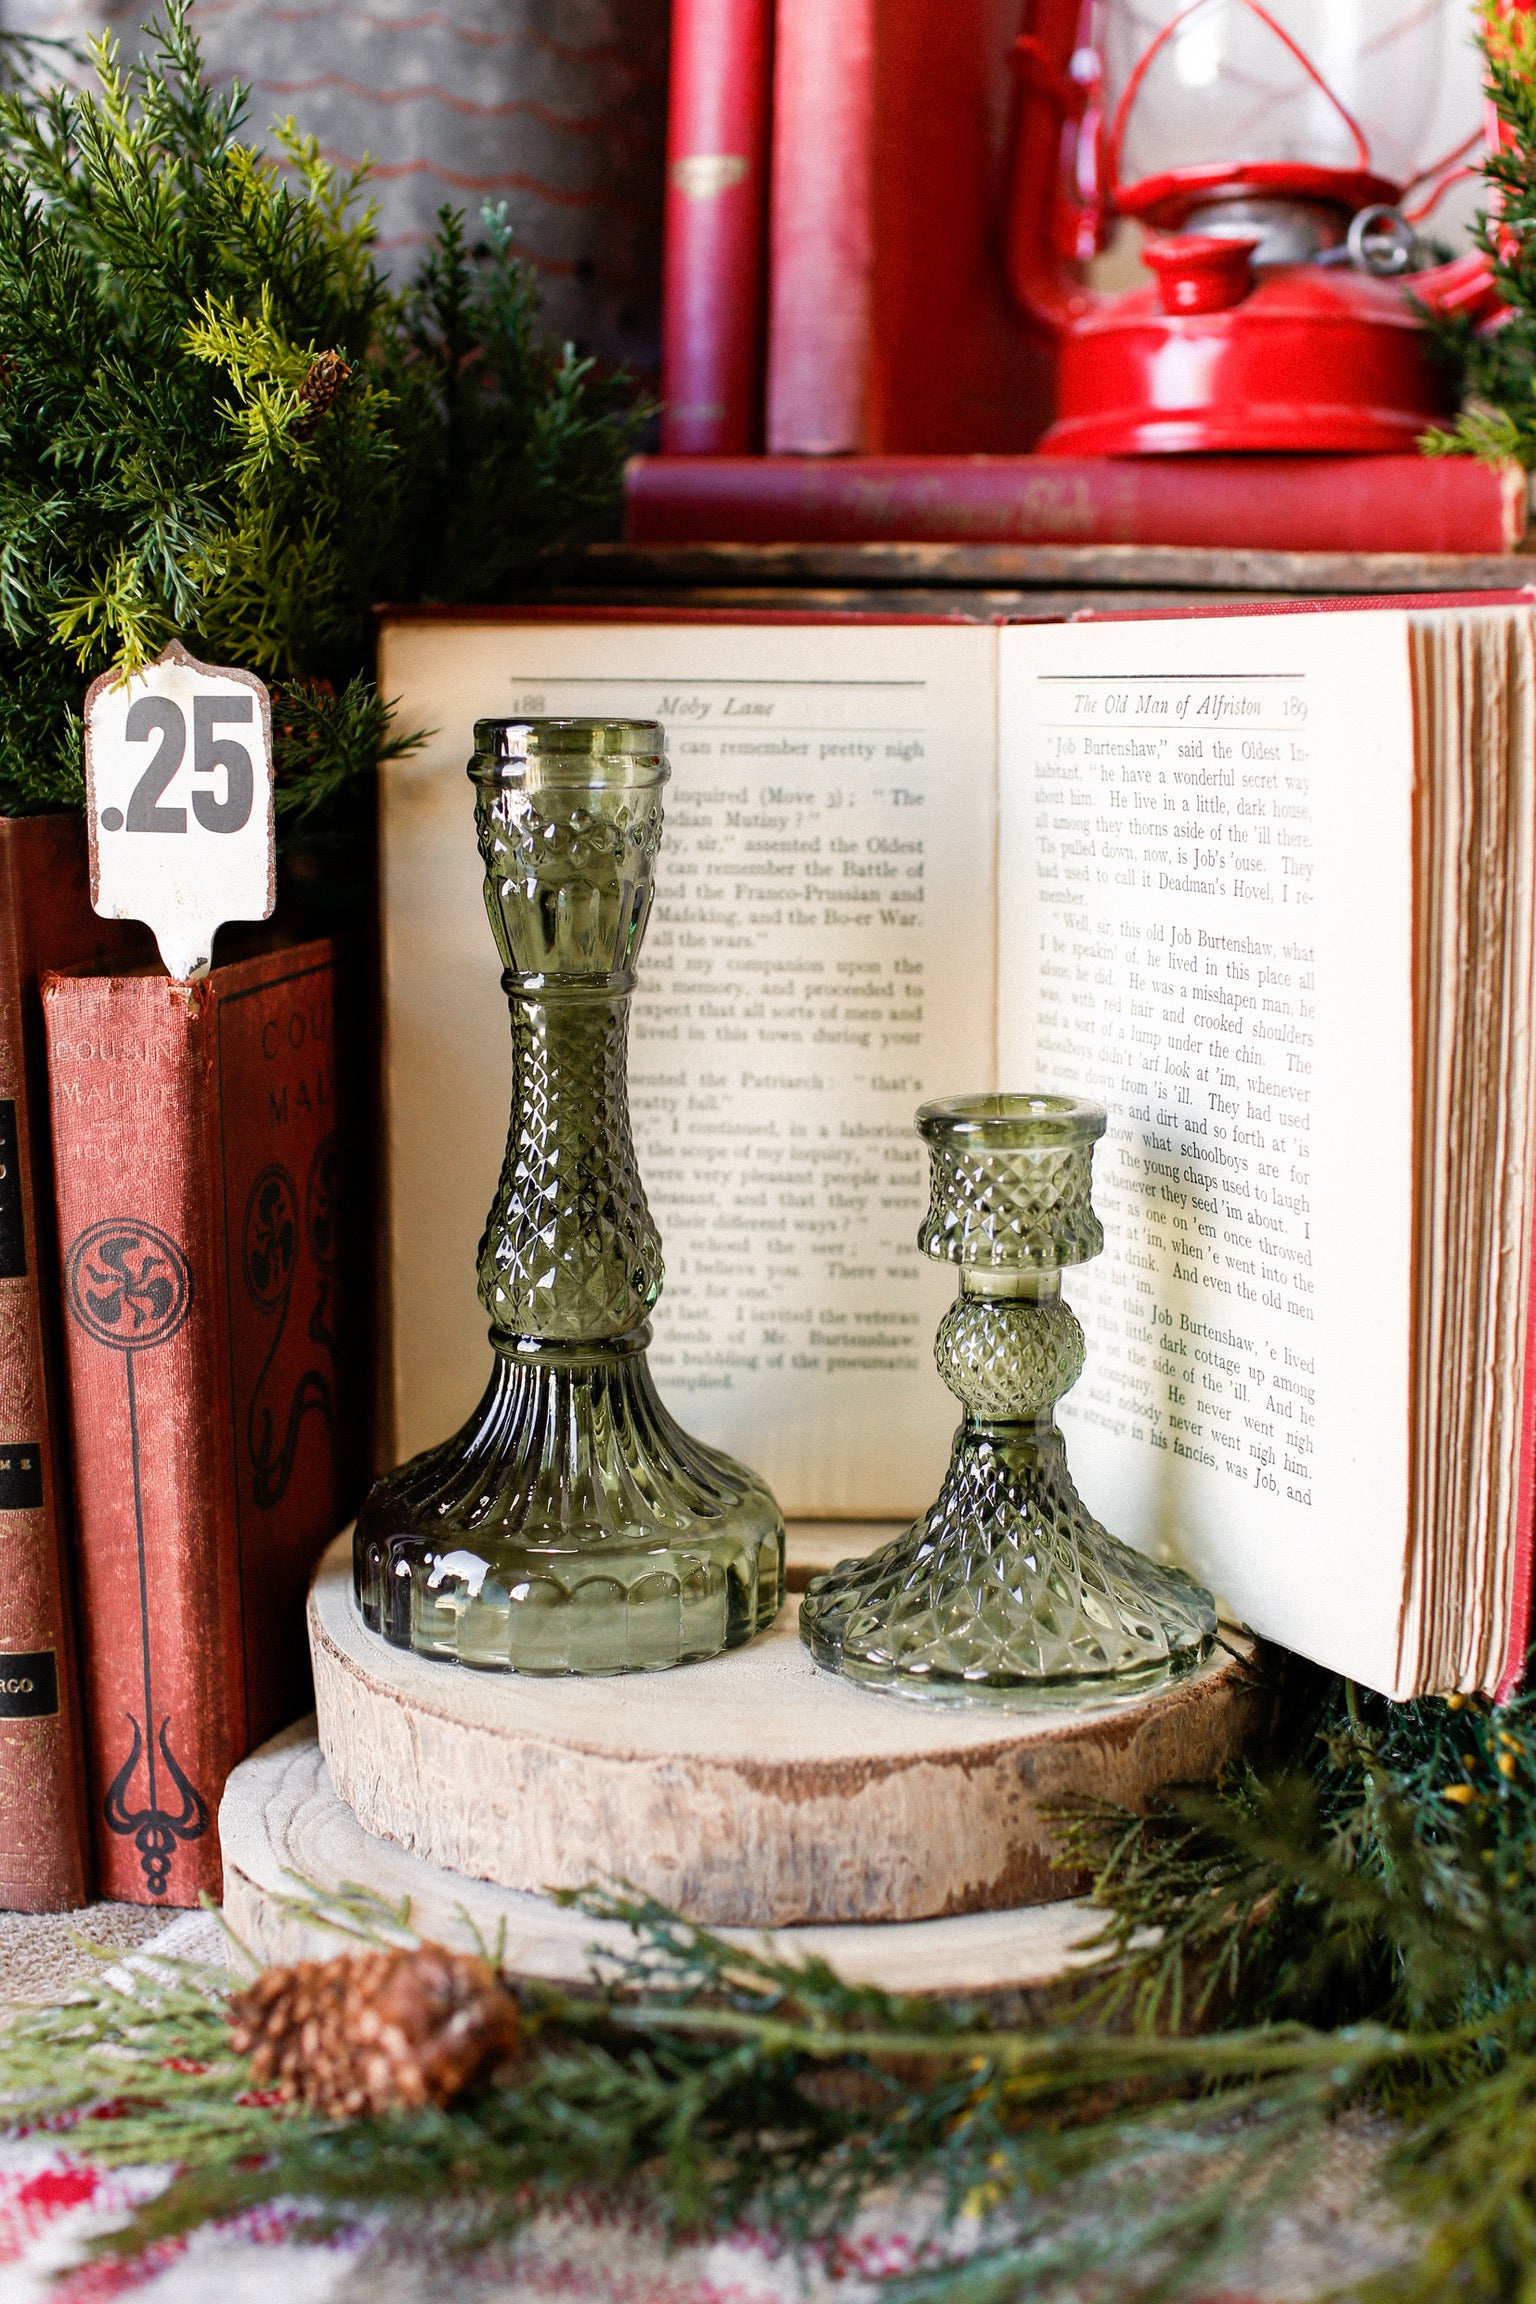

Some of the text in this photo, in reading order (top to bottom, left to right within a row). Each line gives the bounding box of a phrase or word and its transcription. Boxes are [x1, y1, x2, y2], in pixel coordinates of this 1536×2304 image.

[656, 697, 711, 720] Moby
[723, 697, 775, 716] Lane
[1073, 694, 1308, 721] The Old Man of Alfriston 189
[101, 696, 253, 833] .25
[720, 738, 808, 756] remember
[819, 742, 876, 761] pretty
[1178, 741, 1202, 757] said
[1212, 741, 1232, 758] the
[1242, 741, 1281, 760] Oldest
[1122, 765, 1311, 796] have a wonderful secret way
[1110, 790, 1312, 823] He live in little, dark house,
[866, 836, 924, 854] Oldest
[1096, 816, 1313, 848] they thorns aside of the there.
[1101, 841, 1314, 881] down, now, is Job’s They
[1115, 868, 1274, 904] call Deadman’s Hovel,
[1120, 921, 1314, 962] this old Job Burtenshaw, what
[1148, 949, 1316, 991] he lived in this place all
[1129, 972, 1316, 1020] He was misshapen man, he
[1131, 999, 1314, 1048] hair and crooked shoulders
[55, 1040, 175, 1062] COUSIN
[1131, 1025, 1312, 1076] lump under the chin. The
[1121, 1074, 1310, 1130] from They had used
[1164, 1056, 1311, 1103] look at ’im, whenever
[1129, 1105, 1150, 1122] and
[1157, 1108, 1178, 1128] dirt
[1185, 1118, 1207, 1135] and
[1214, 1125, 1226, 1140] so
[1232, 1126, 1264, 1148] forth
[1272, 1138, 1286, 1152] at
[1118, 1148, 1310, 1216] The young chaps used to laugh
[1142, 1132, 1310, 1186] what schoolboys are for
[1161, 1185, 1288, 1234] they seed about.
[1146, 1209, 1312, 1267] one on once throwed
[1125, 1248, 1314, 1321] drink. And even the old men
[1172, 1238, 1314, 1294] when went into the
[1151, 1304, 1315, 1375] Job Burtenshaw, lived
[1152, 1356, 1316, 1427] side of the And he
[1160, 1333, 1316, 1405] dark cottage up among
[1168, 1384, 1314, 1454] He never went nigh
[1151, 1430, 1312, 1506] his fancies, was Job, and
[1170, 1413, 1312, 1480] never went nigh him.
